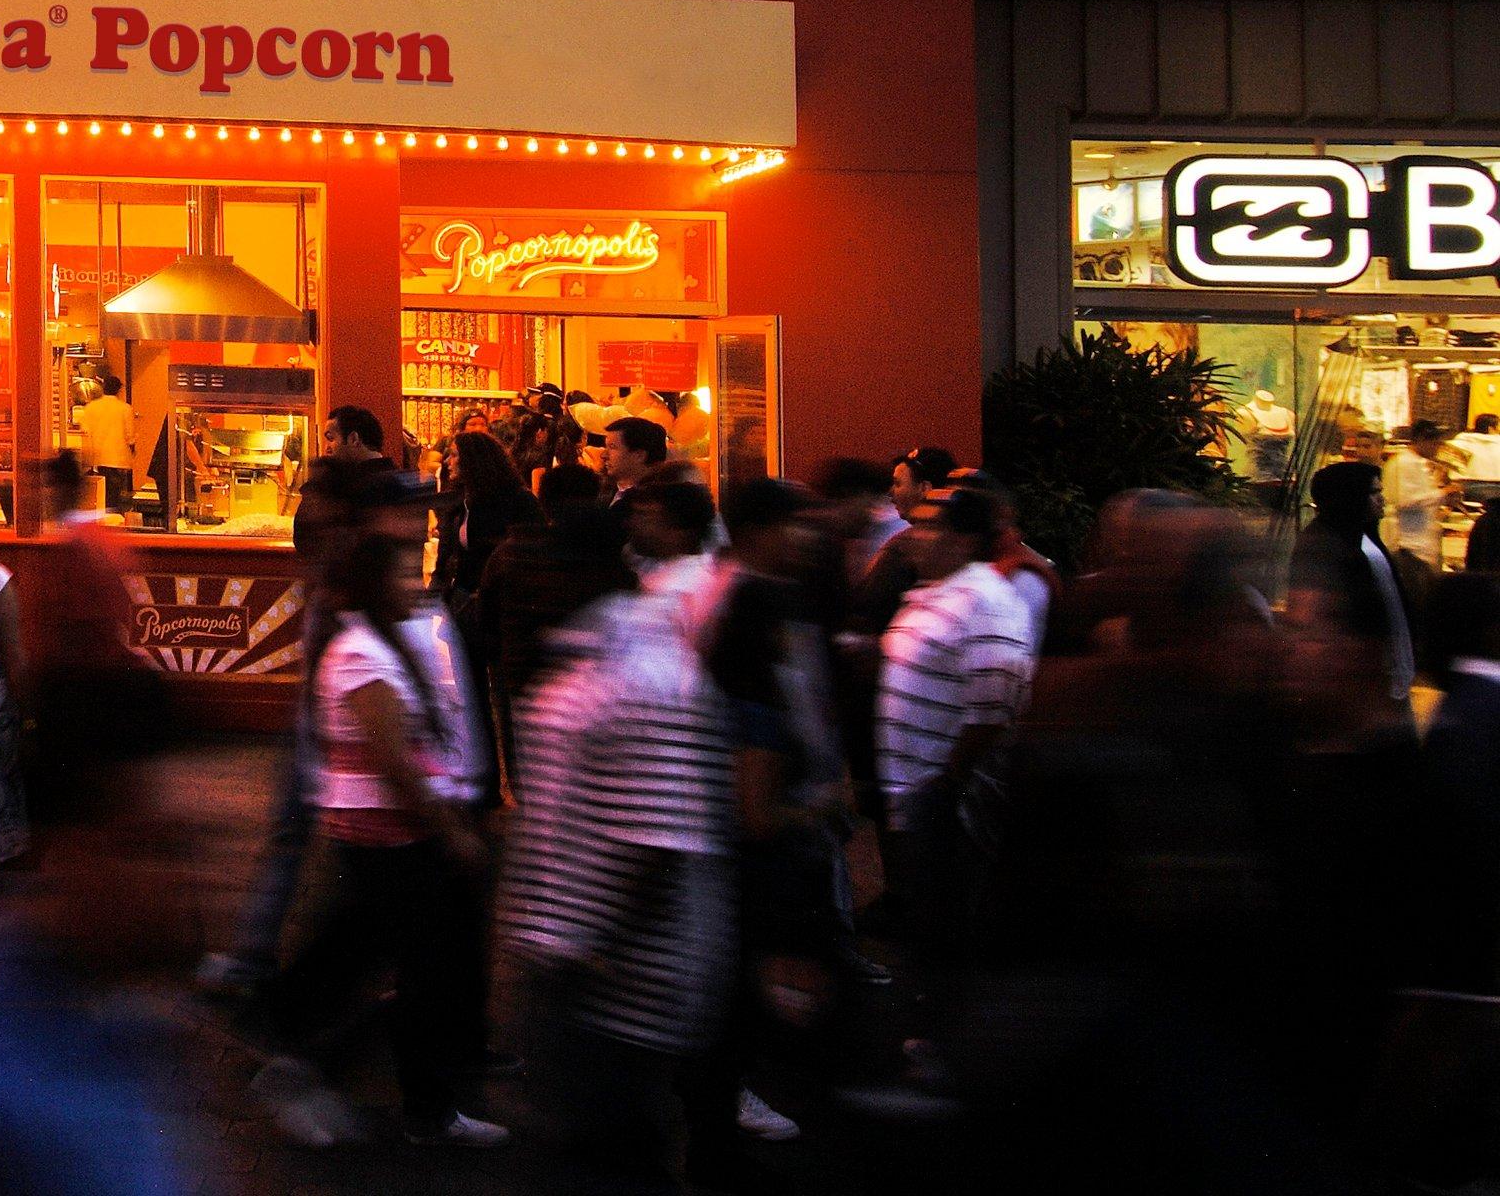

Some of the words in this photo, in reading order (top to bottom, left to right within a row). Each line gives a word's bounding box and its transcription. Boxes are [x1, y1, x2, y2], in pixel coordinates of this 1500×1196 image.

[91, 6, 455, 94] Popcorn
[434, 218, 660, 293] Popcornopolis
[1408, 165, 1500, 271] B
[416, 339, 480, 357] CANDY
[135, 606, 242, 645] Popcornopolis
